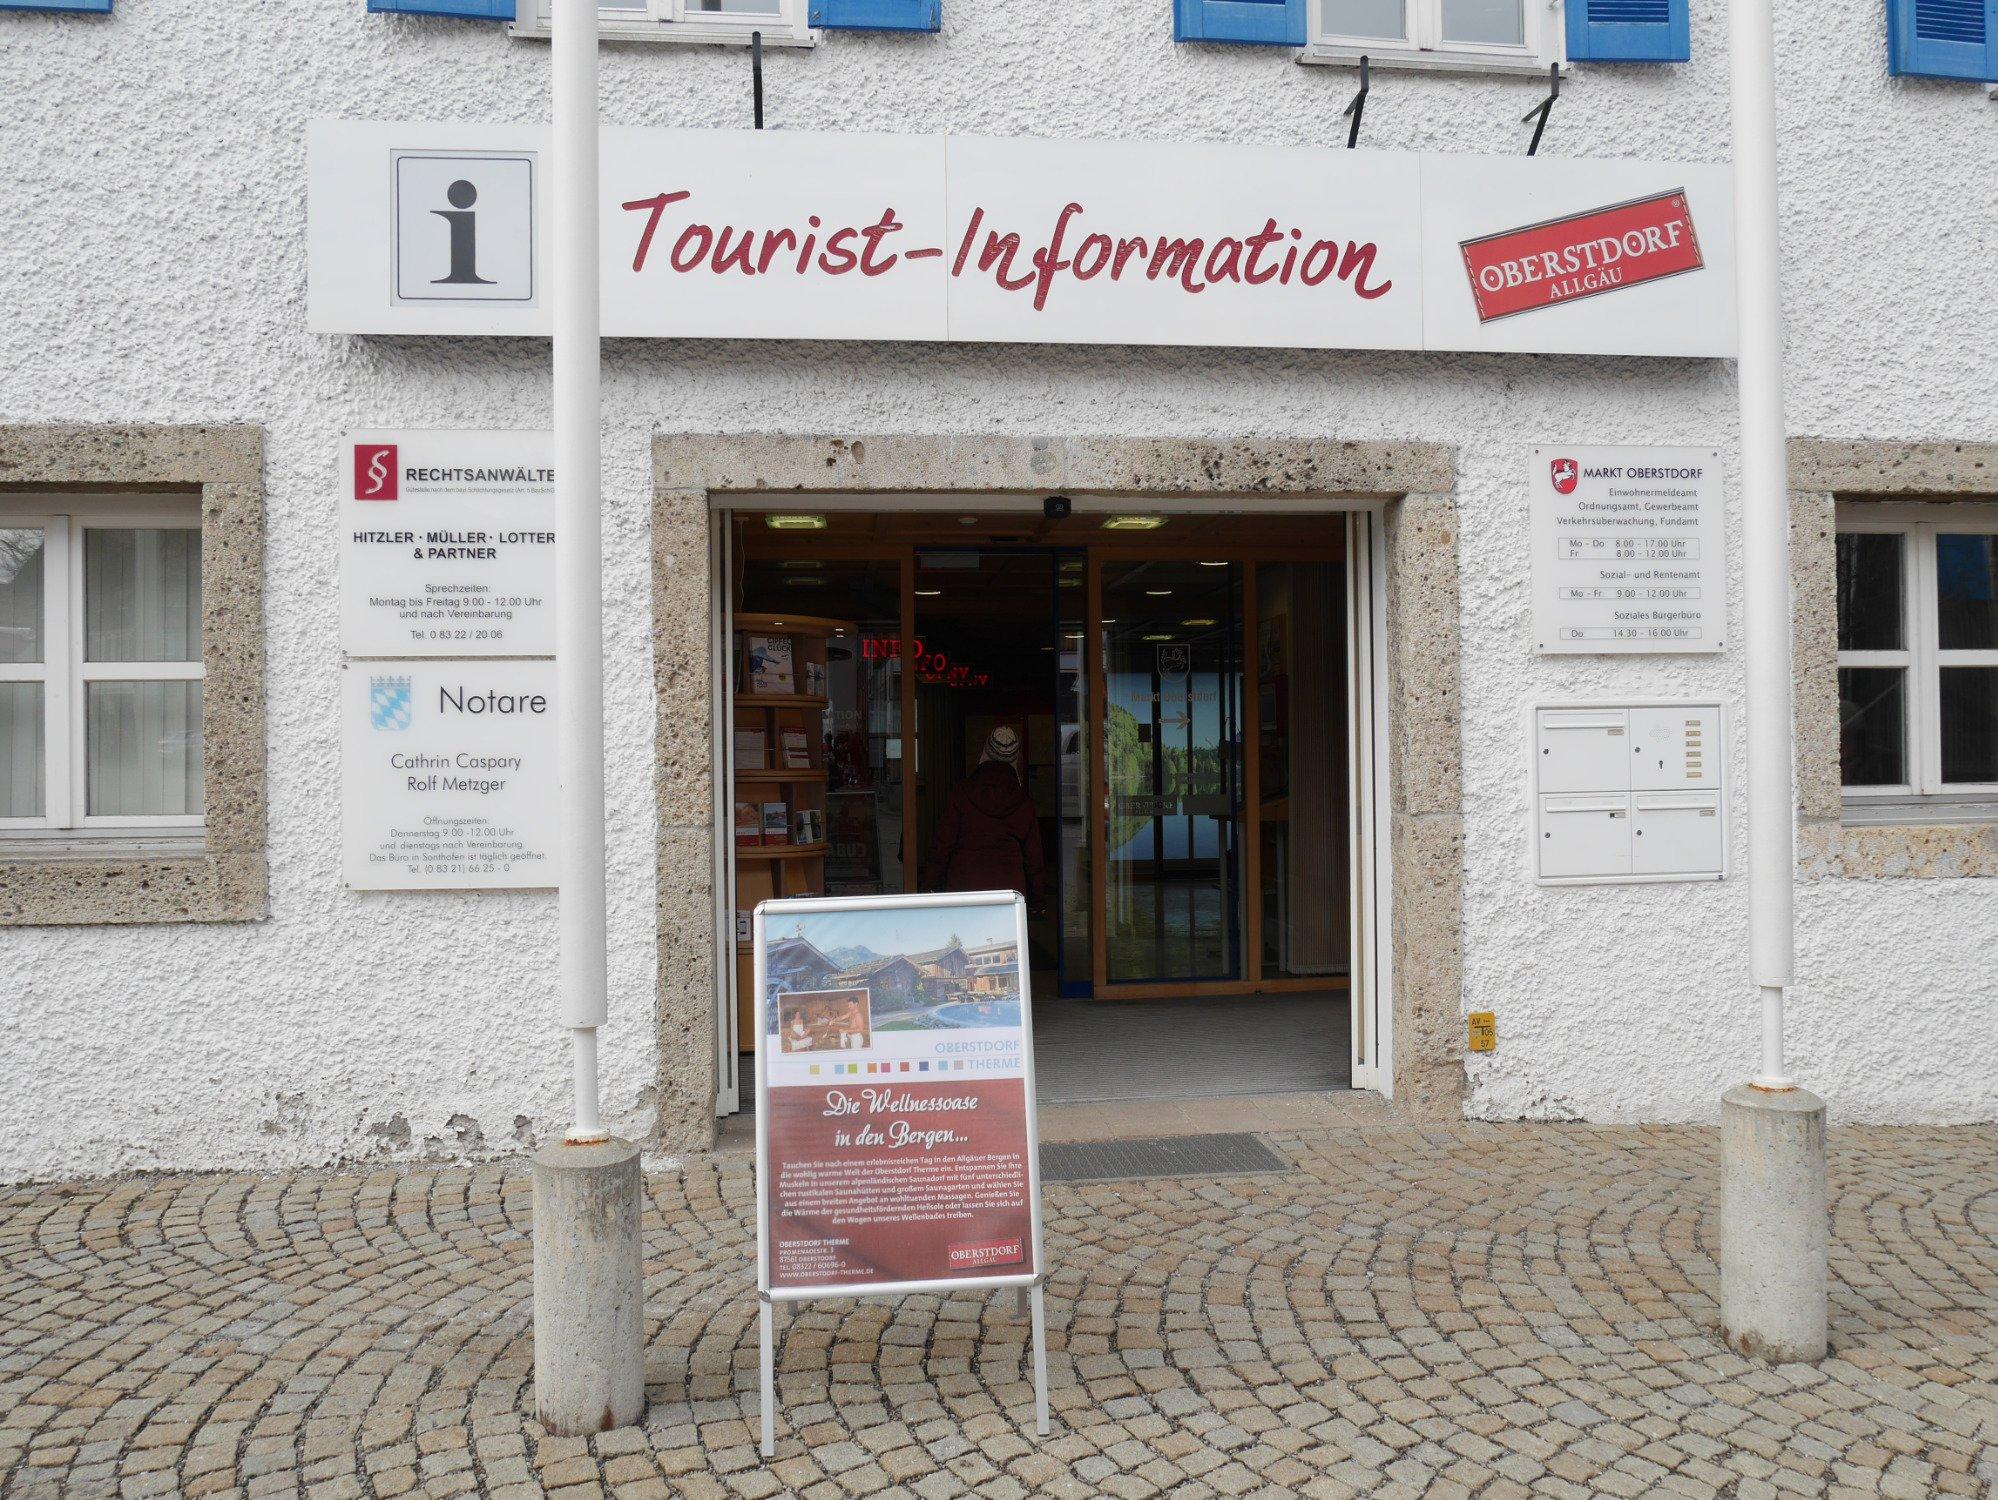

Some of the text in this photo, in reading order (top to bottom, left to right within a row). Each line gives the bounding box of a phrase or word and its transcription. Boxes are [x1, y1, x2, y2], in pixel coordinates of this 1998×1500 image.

[620, 190, 1393, 312] Tourist-Information
[1479, 220, 1683, 292] OBERSTDORF
[1549, 266, 1623, 299] ALLGÄU
[406, 466, 554, 482] RECHTSANWÄLTE
[1583, 468, 1703, 479] MARKT OBERSTDORF
[1609, 487, 1698, 497] Einwohnermeldeamt
[1578, 501, 1699, 512] Ordnungsamt, Gewerbeamt
[1660, 517, 1699, 526] Fundamt
[353, 530, 555, 544] HITZLER MÜLLER LOTTER
[1569, 539, 1686, 548] Mo Do Uhr
[413, 548, 497, 559] & PARTNER
[1569, 549, 1687, 558] Fr Uhr
[1600, 570, 1701, 579] Sozial- und Rentenamt
[1570, 590, 1688, 598] Mo Fr Uhr
[369, 598, 406, 608] Montag
[409, 597, 423, 606] bis
[426, 597, 460, 608] Freitag
[524, 597, 542, 607] Uhr
[399, 610, 513, 620] und nach Vereinbarung
[1614, 611, 1650, 620] Soziales
[1571, 629, 1584, 638] Do
[1674, 629, 1689, 638] Uhr
[440, 686, 547, 714] Notare
[391, 752, 521, 772] Cathrin Caspary
[407, 775, 506, 795] Rolf Metzger
[390, 827, 515, 840] Donnerstag Uhr
[380, 839, 523, 852] und dienstags nach Vereinbarung
[369, 853, 386, 863] Das
[422, 852, 465, 862] Sonthofen
[935, 1040, 1020, 1054] OBERSTDORF
[968, 1057, 1021, 1070] THERME
[823, 1088, 979, 1117] Die Wellnessoase
[834, 1130, 851, 1148] in
[855, 1123, 885, 1147] den
[920, 1156, 933, 1165] Tag
[942, 1155, 956, 1163] den
[987, 1153, 1012, 1162] Bergen
[1013, 1180, 1024, 1188] Sie
[945, 1202, 961, 1210] oder
[984, 1200, 996, 1208] Sie
[996, 1199, 1010, 1208] sich
[779, 1238, 850, 1248] OBERSTDORF THERME
[951, 1244, 1020, 1260] OBERSTDORF
